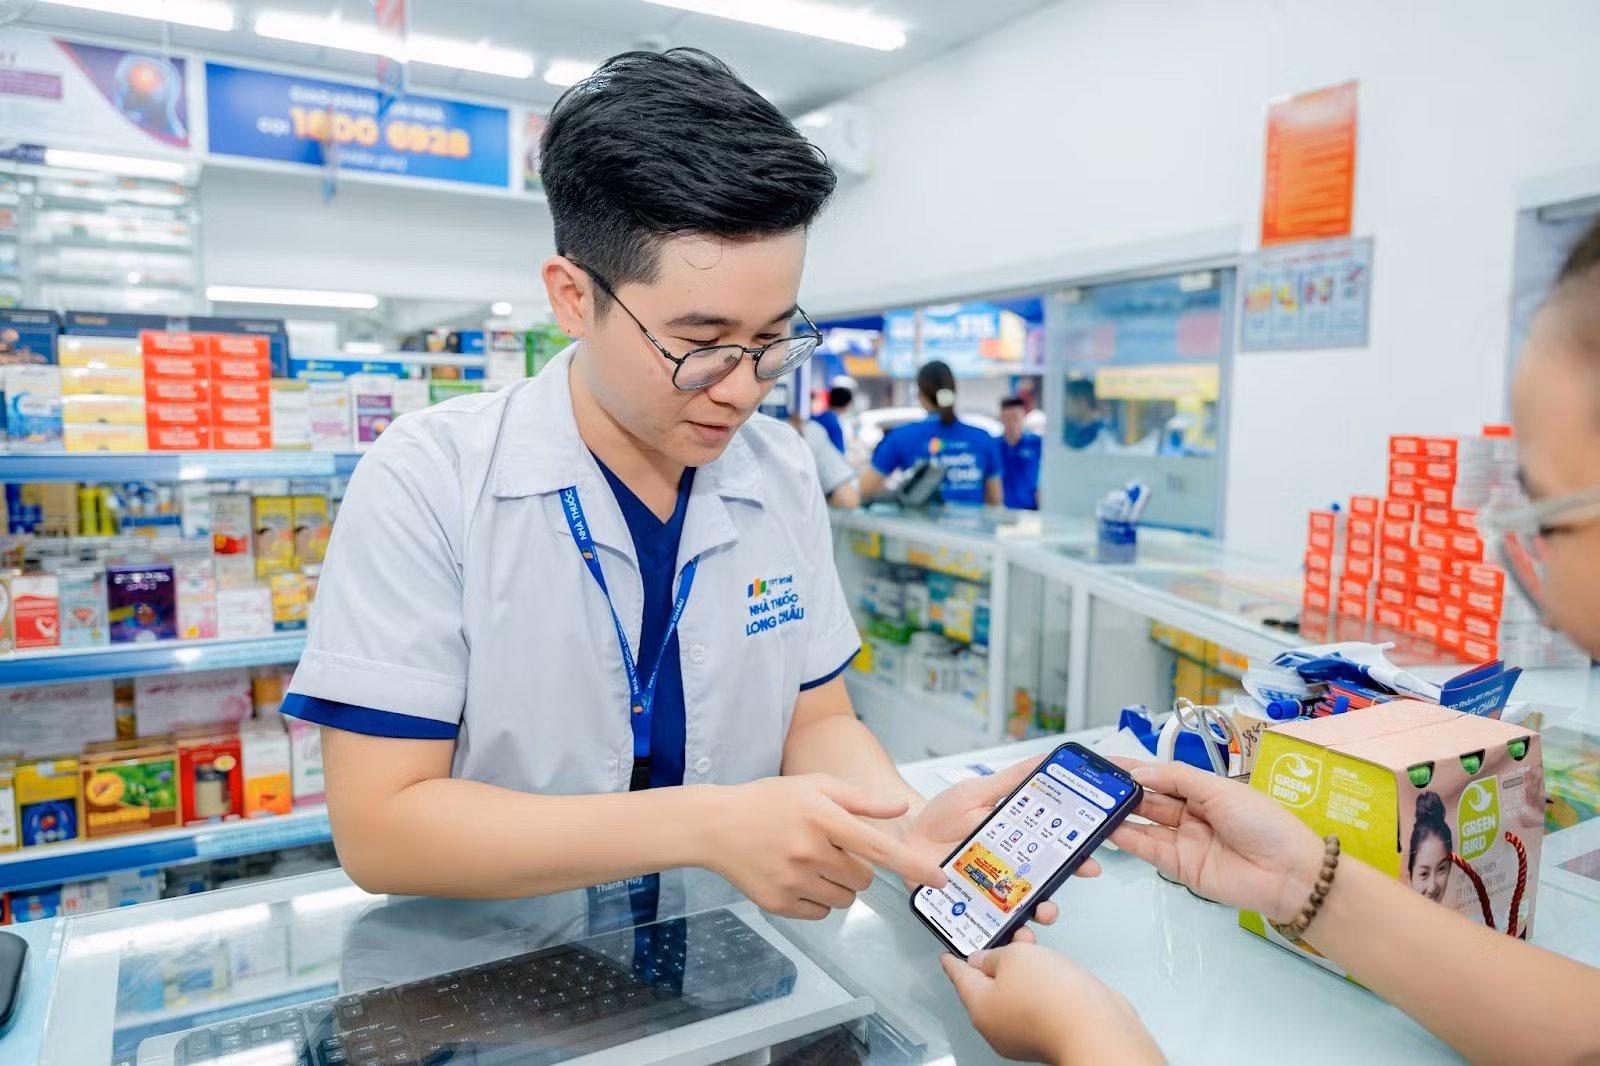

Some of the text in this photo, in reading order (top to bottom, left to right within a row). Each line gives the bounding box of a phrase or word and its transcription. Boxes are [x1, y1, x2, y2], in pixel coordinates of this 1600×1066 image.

[574, 520, 587, 541] NHÀ
[749, 588, 799, 616] NHÀ THUỐC
[746, 616, 777, 636] LONG
[1273, 785, 1298, 802] BIRD
[1275, 774, 1312, 794] GREEN
[1462, 815, 1496, 837] GREEN
[1463, 836, 1486, 855] BIRD
